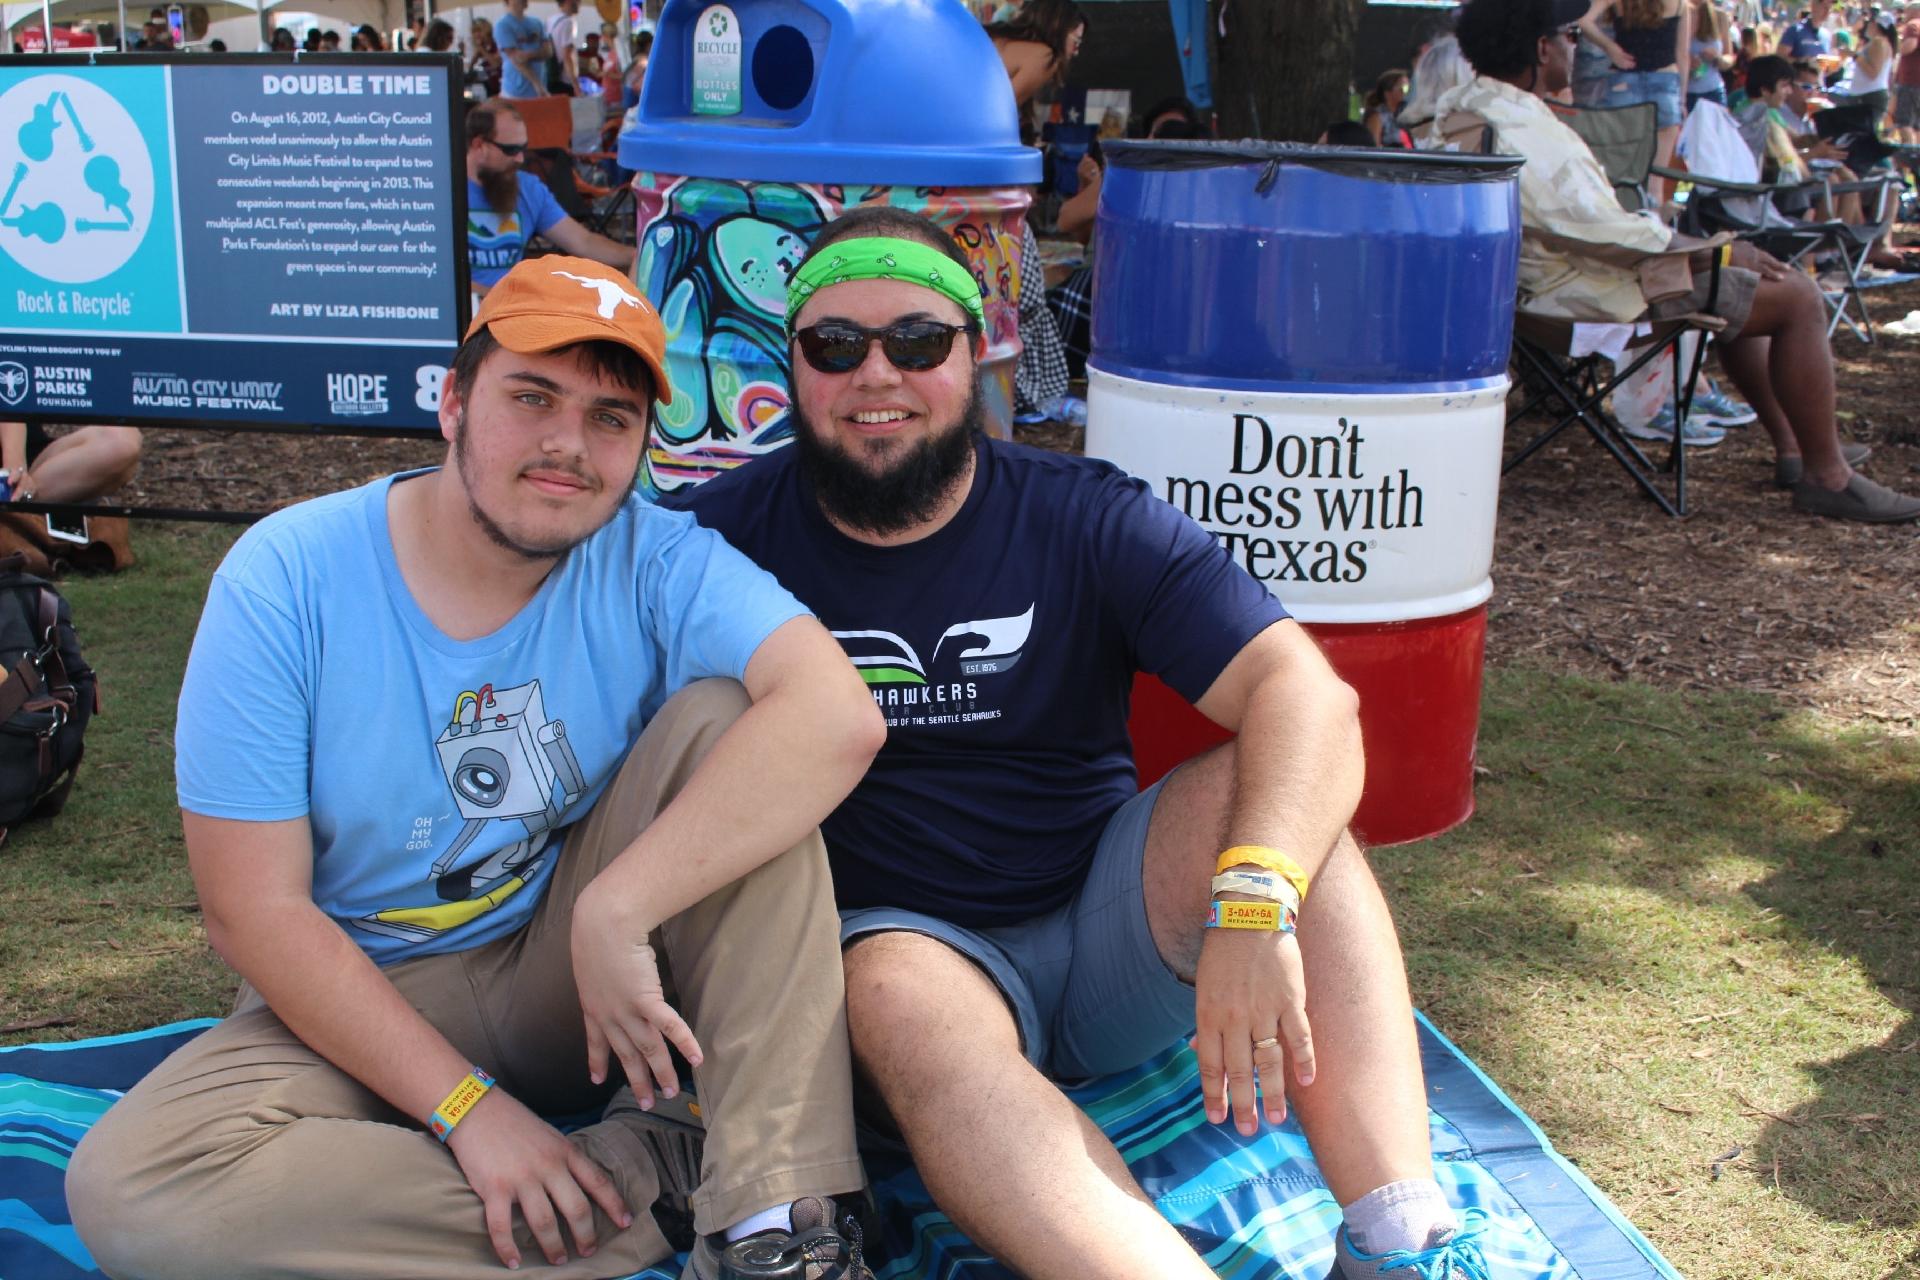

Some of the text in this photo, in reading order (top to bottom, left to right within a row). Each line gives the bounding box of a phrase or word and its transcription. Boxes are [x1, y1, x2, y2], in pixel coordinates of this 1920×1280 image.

[697, 42, 738, 54] RECYCLE
[262, 75, 431, 95] DOUBLE TIME
[703, 91, 728, 102] ONLY
[231, 111, 432, 128] On August 16, 2012, Austin City Council
[204, 132, 433, 149] members voted unanimously to allow the Austin
[228, 153, 433, 172] City Limits Music Festival to expand to two
[217, 175, 434, 193] consecutive weekends beginning in 2013. This
[236, 196, 435, 212] expansion meant more fans, which in turn
[206, 216, 435, 236] multiplied ACL Fest's generosity, allowing Austin
[222, 237, 437, 256] Parks Foundation's to expand our care for the
[286, 260, 437, 278] green spaces in our community!
[17, 289, 131, 320] Rock & Recycle
[270, 303, 439, 320] ART BY LIZA FISHBONE
[28, 345, 48, 354] TOUR
[48, 346, 82, 355] BROUGHT
[84, 347, 95, 356] TO
[95, 348, 110, 356] YOU
[111, 348, 122, 357] BY
[34, 366, 92, 381] AUSTIN
[35, 381, 87, 396] PARKS
[132, 377, 189, 395] AUSTIN
[192, 379, 228, 396] CITY
[327, 373, 388, 403] HOPE
[37, 397, 93, 408] FOUNDATION
[133, 394, 284, 411] MUSIC FESTIVAL
[1229, 413, 1364, 479] Don't
[1166, 469, 1423, 531] mess with
[1207, 531, 1367, 583] Texas
[966, 663, 981, 674] EST.
[873, 683, 977, 706] HAWKERS
[885, 709, 1001, 727] LUB OF THE SEATTLE SEAHAWKS
[415, 817, 432, 828] OH
[412, 828, 431, 839] MY
[406, 839, 432, 850] GOD.
